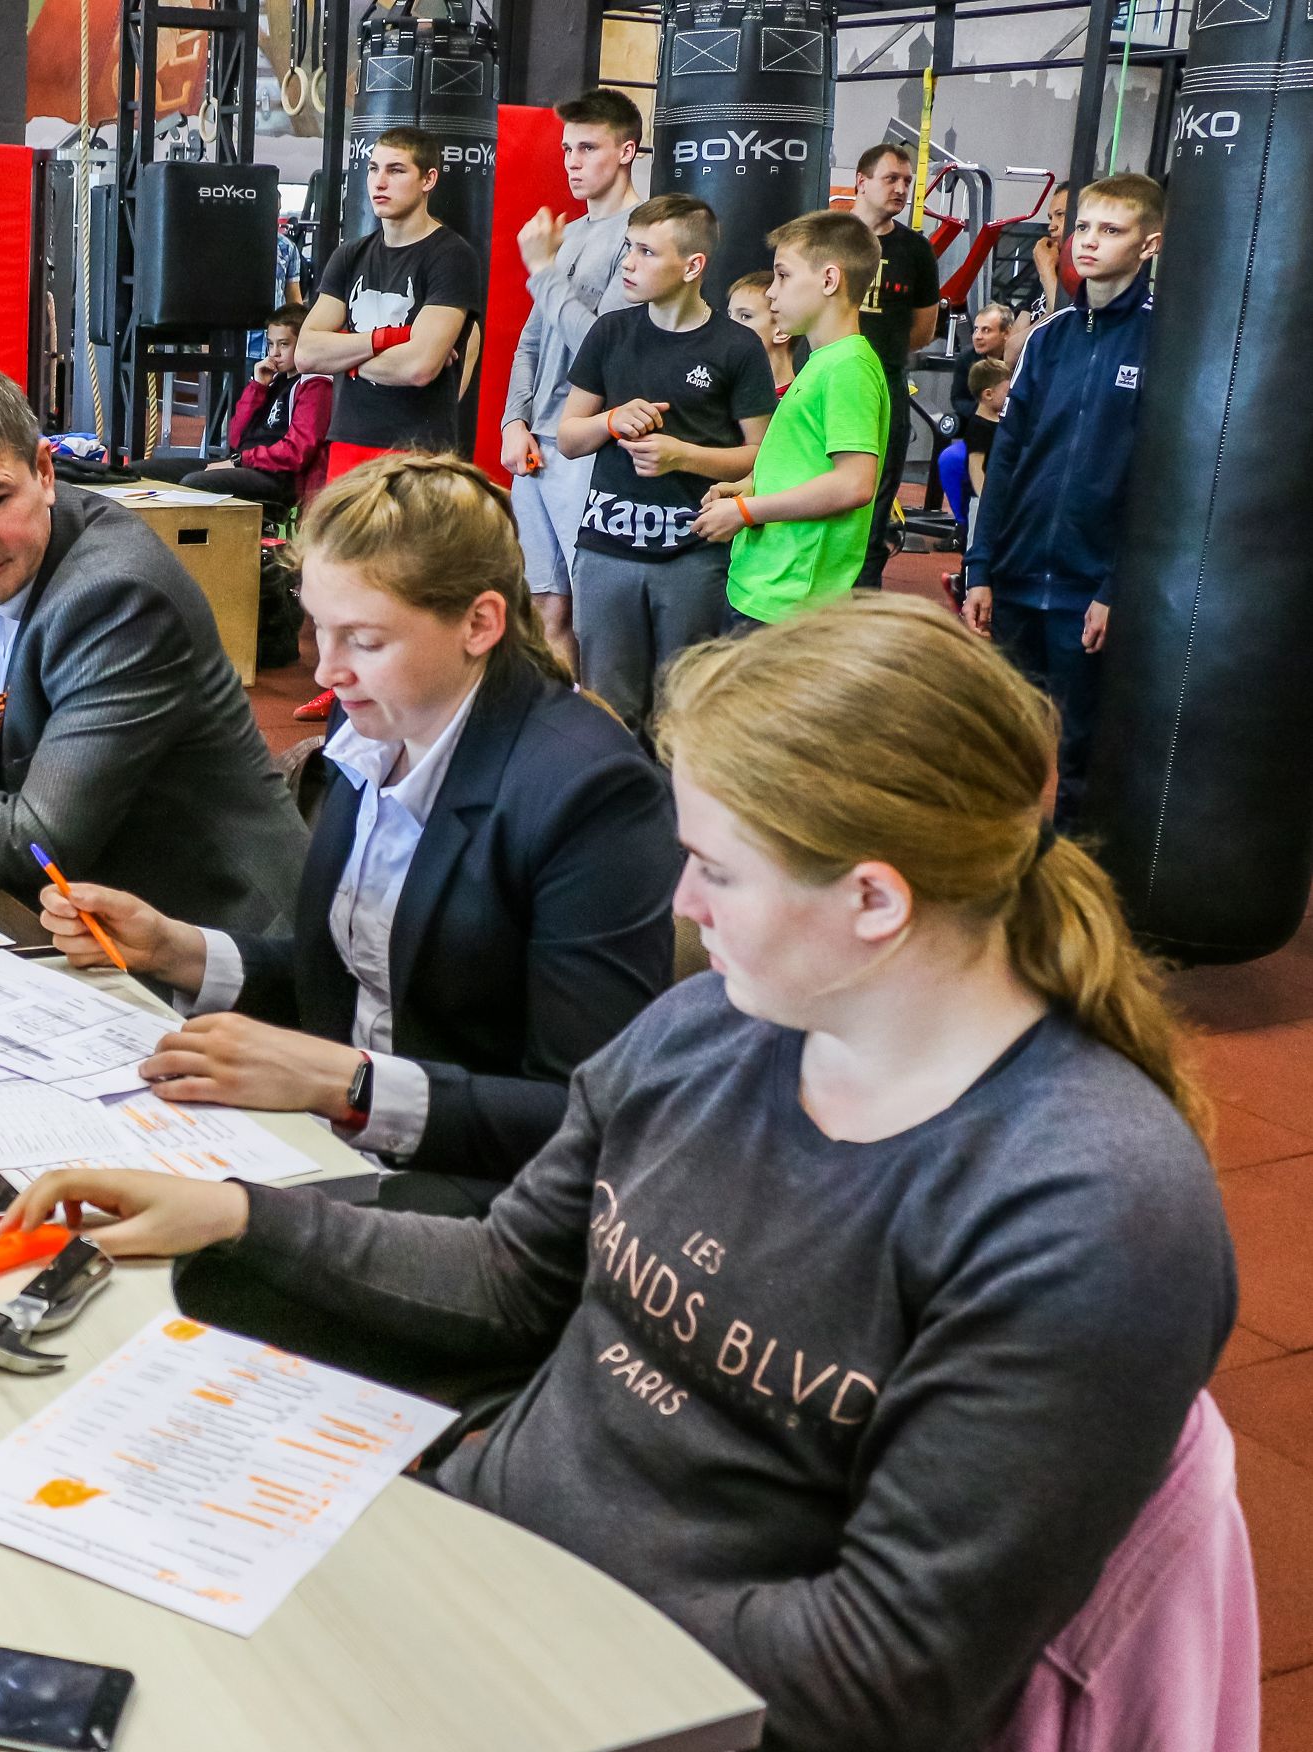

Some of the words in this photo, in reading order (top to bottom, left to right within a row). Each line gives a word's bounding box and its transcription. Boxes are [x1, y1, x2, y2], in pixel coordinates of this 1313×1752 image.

[1174, 104, 1241, 141] YKO
[441, 143, 496, 167] BOYK
[672, 130, 808, 163] BOYKO
[1176, 143, 1236, 158] ORT
[442, 164, 488, 176] SPO
[674, 165, 805, 178] SPORT
[198, 184, 257, 199] BOYKO
[581, 488, 694, 547] Kapp
[681, 1231, 726, 1275] LES
[597, 1341, 689, 1416] PARIS
[717, 1318, 879, 1425] BLVD
